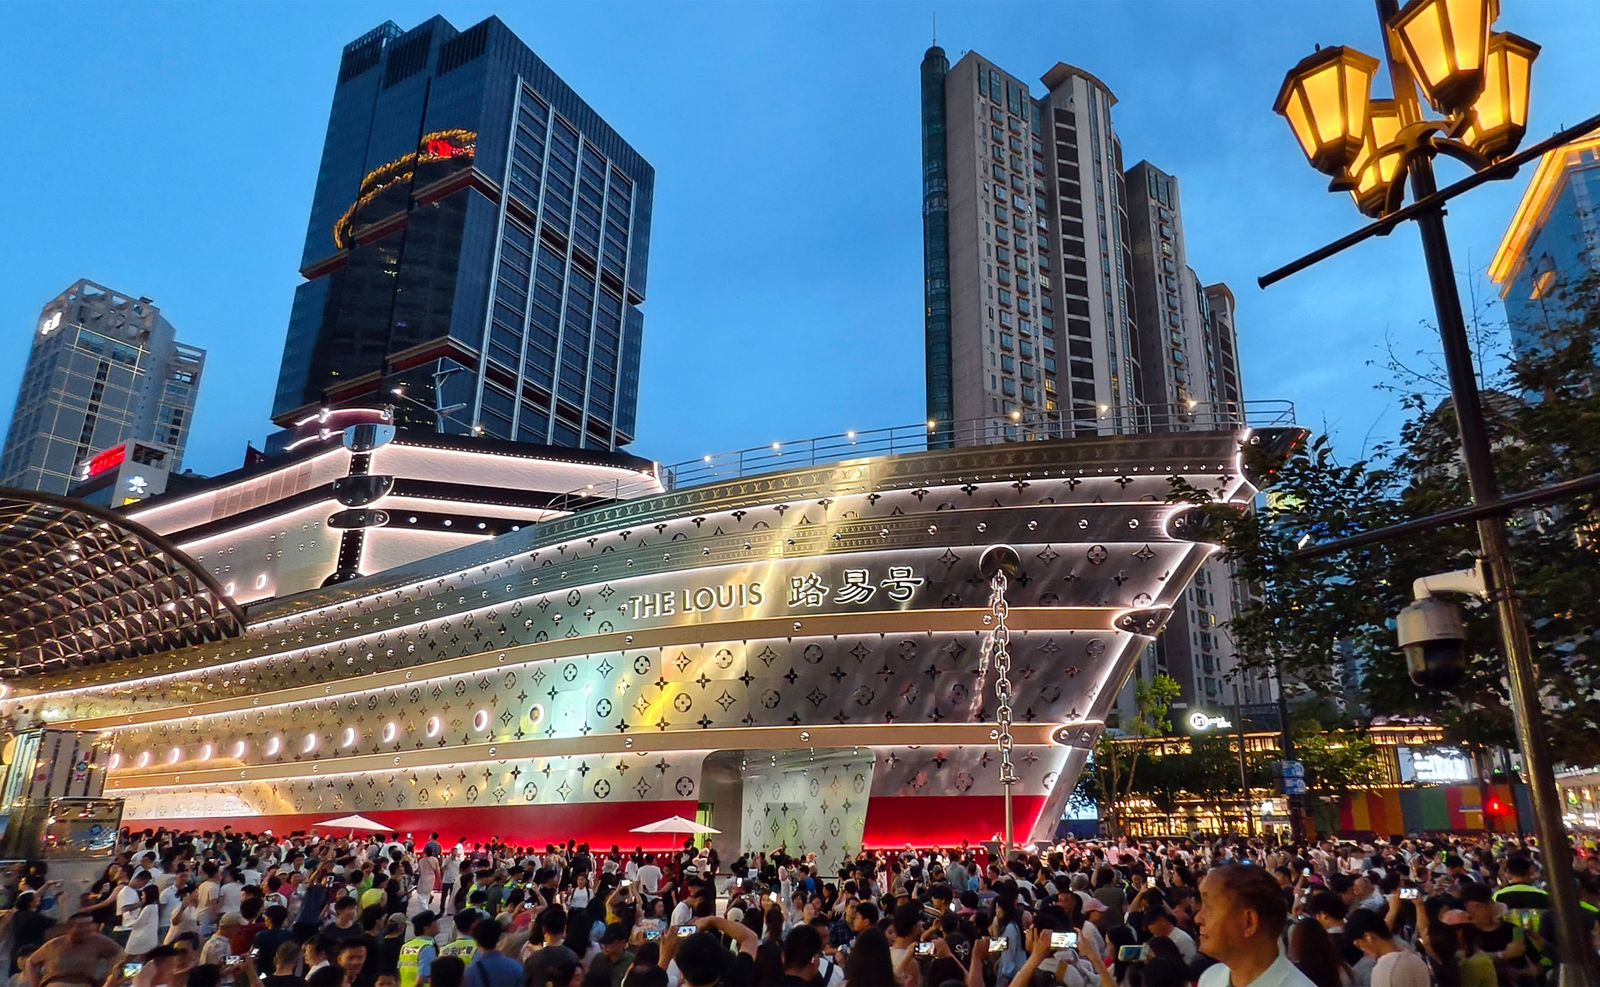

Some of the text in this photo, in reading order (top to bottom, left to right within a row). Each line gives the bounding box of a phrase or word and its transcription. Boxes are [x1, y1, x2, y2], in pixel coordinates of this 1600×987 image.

[629, 582, 764, 620] THE LOUIS
[787, 566, 924, 608] 路易号
